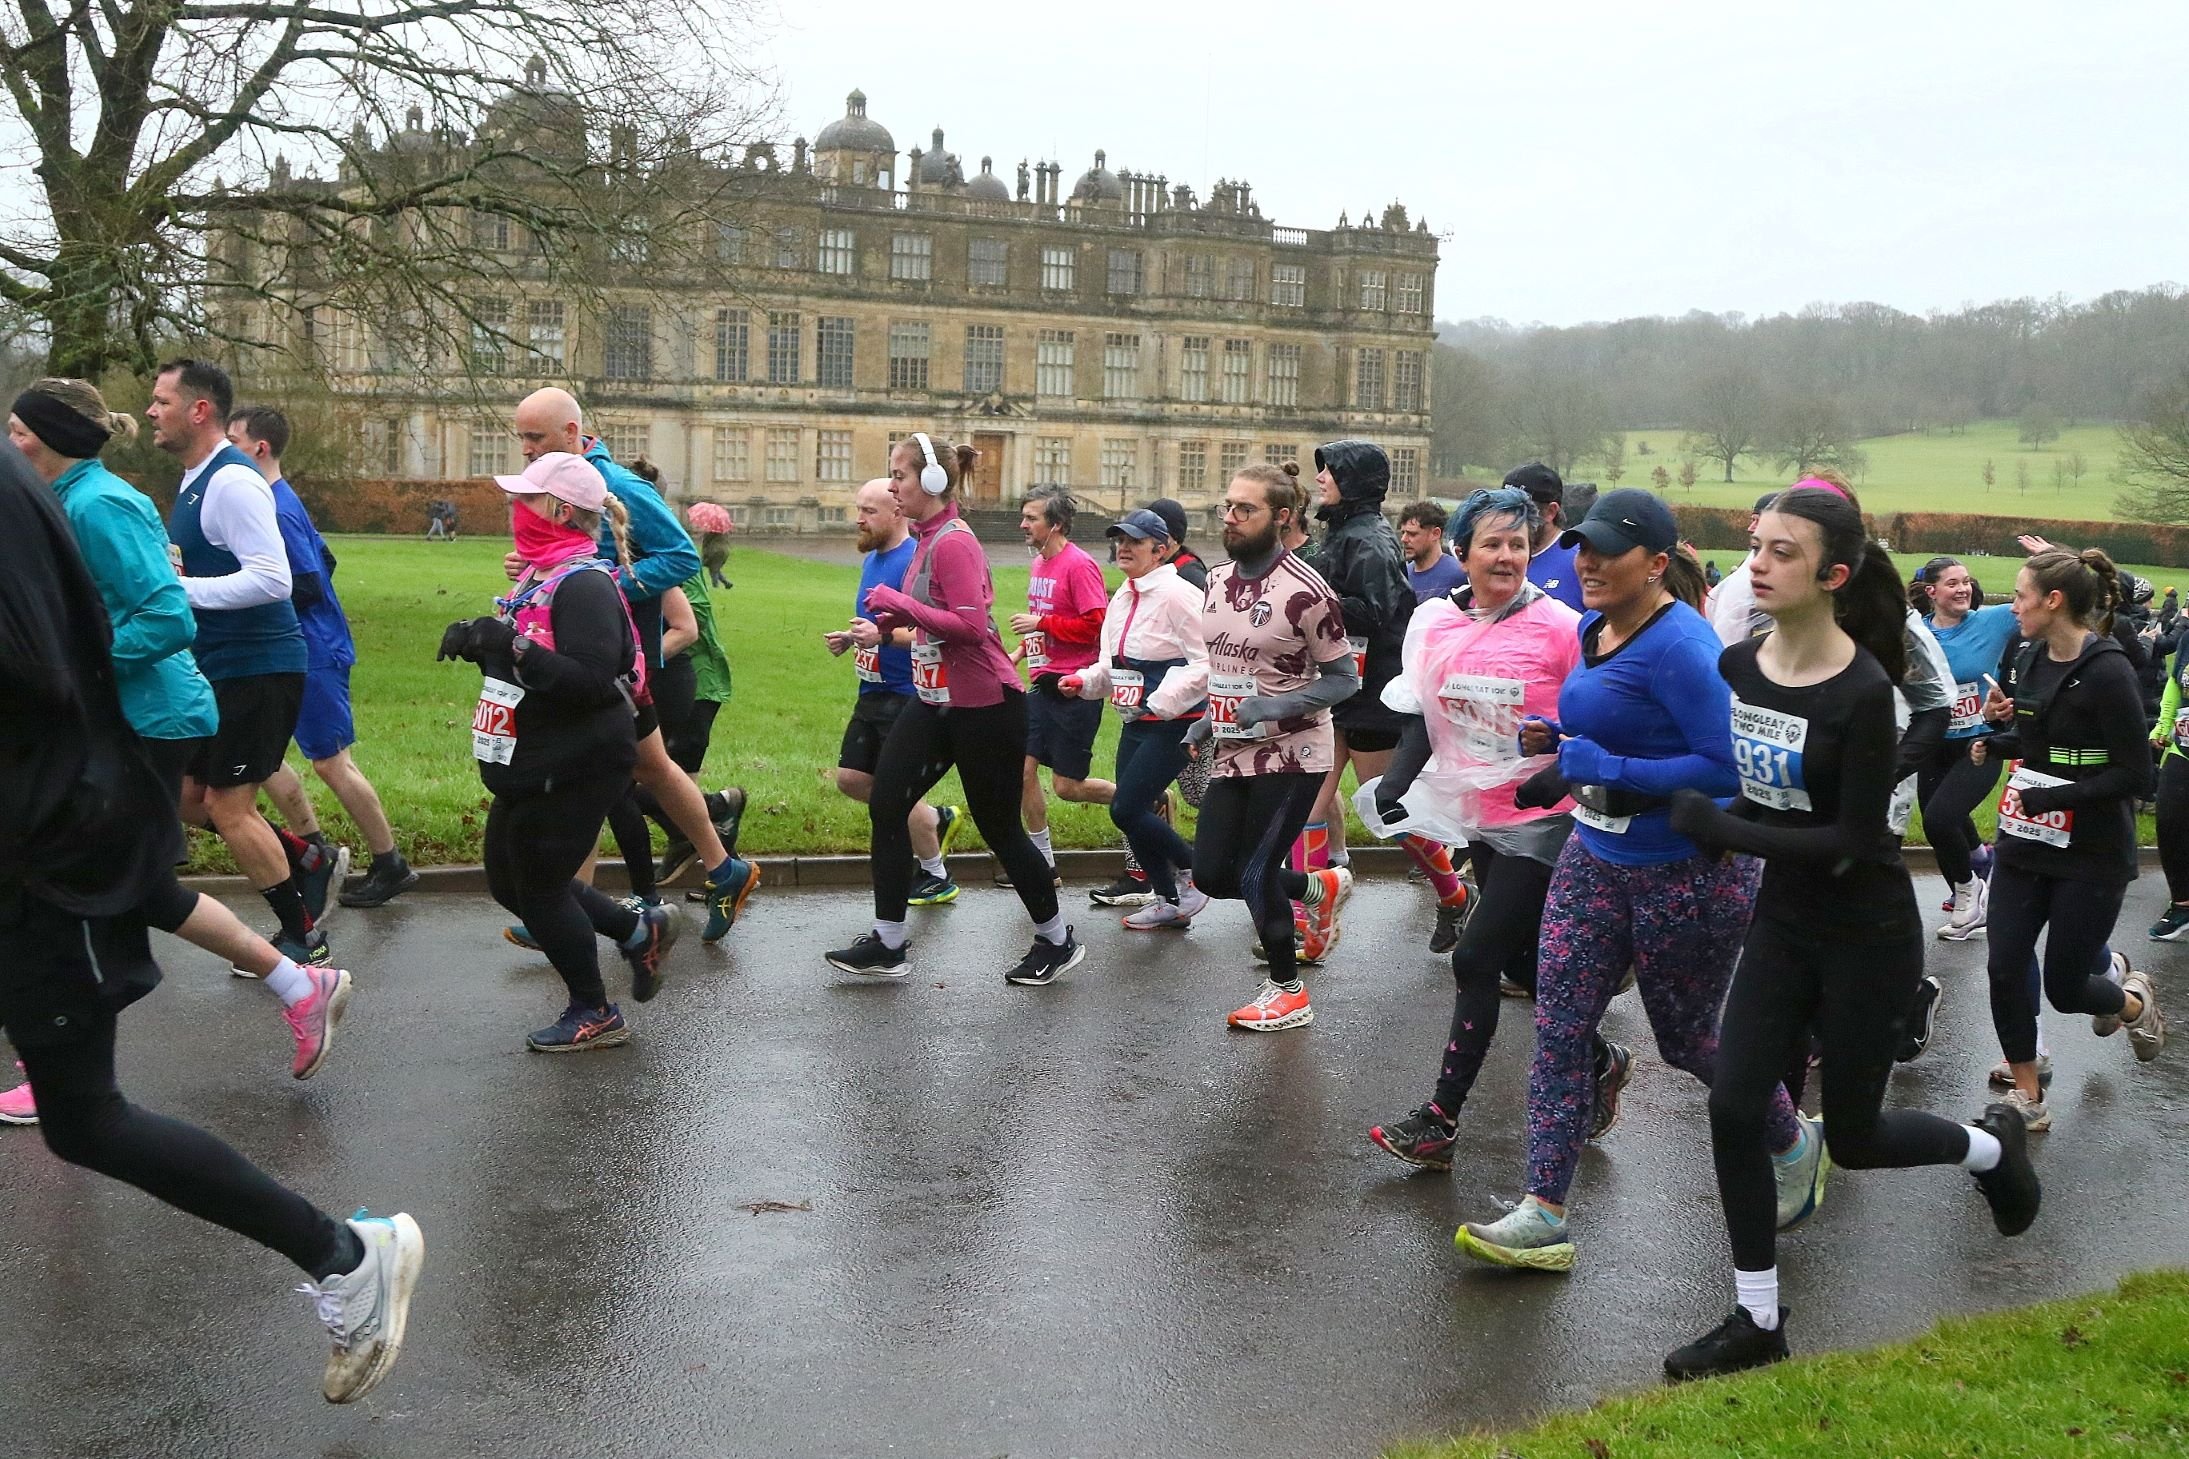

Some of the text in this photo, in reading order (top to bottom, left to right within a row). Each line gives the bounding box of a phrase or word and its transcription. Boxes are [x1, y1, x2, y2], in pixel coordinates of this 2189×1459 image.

[1029, 577, 1057, 598] OAST
[1206, 632, 1260, 662] Alaska
[1209, 694, 1248, 721] 579
[1731, 708, 1786, 729] LONGLEAT
[1733, 719, 1781, 740] TWO MILE
[1731, 734, 1792, 787] 931
[2016, 824, 2041, 837] 2025
